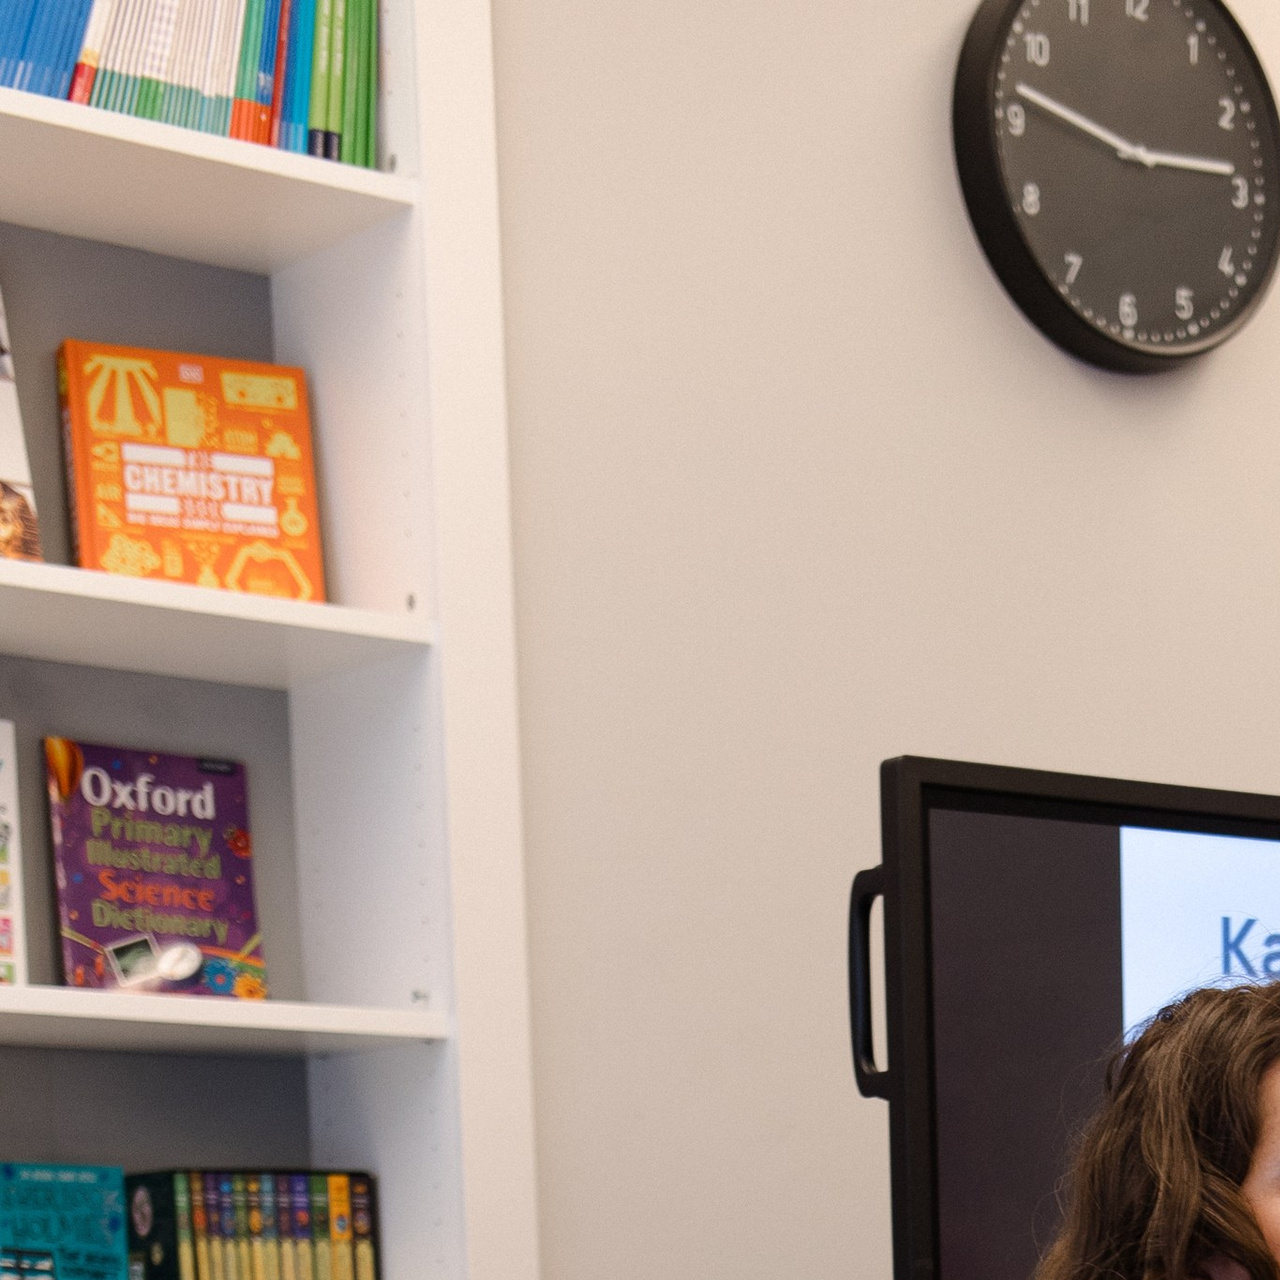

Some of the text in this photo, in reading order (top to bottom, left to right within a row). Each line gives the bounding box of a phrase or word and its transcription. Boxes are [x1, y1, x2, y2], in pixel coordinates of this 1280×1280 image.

[1067, 0, 1091, 25] 11
[1124, 0, 1150, 21] 12
[1024, 32, 1051, 67] 10
[1186, 33, 1200, 66] 1
[1006, 104, 1026, 136] 9
[1217, 97, 1236, 130] 2
[1022, 182, 1041, 216] 8
[1231, 176, 1249, 209] 3
[1063, 251, 1083, 284] 7
[1217, 245, 1235, 276] 4
[1118, 292, 1138, 326] 6
[1174, 285, 1194, 320] 5
[125, 464, 273, 507] CHEMISTRY
[80, 766, 216, 820] Oxford
[90, 806, 213, 859] Primary
[86, 838, 222, 880] Illustrated
[98, 868, 215, 912] Science
[91, 898, 228, 946] Dictionary
